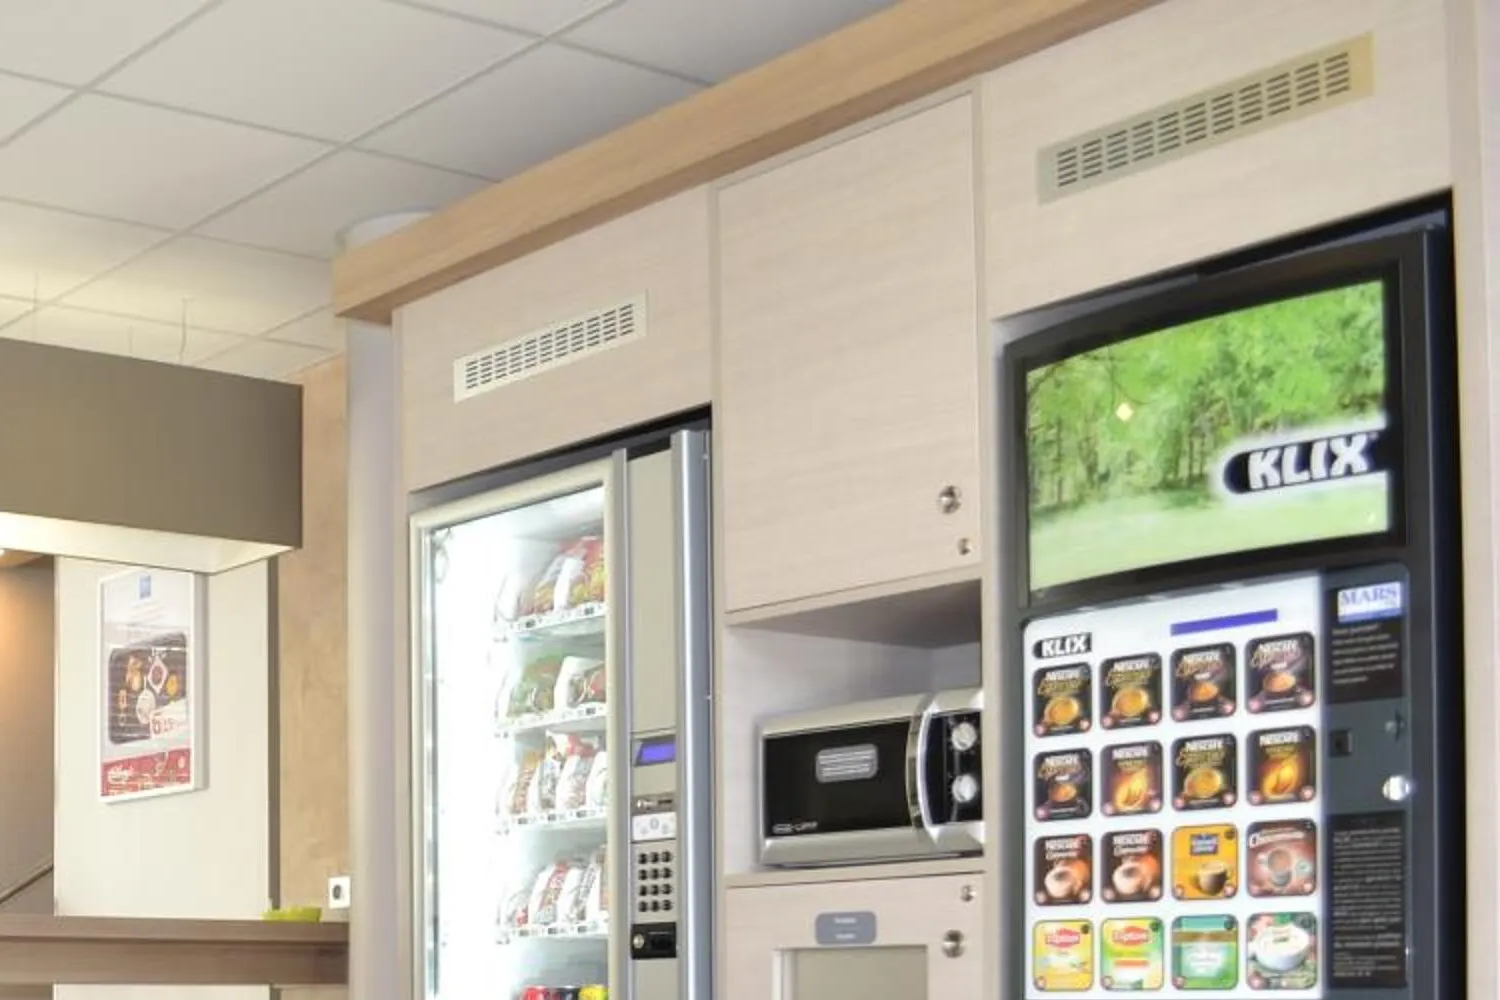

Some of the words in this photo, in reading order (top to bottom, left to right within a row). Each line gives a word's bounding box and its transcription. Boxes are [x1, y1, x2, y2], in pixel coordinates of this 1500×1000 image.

[1247, 433, 1369, 490] KLIX
[1341, 586, 1398, 605] MARS
[1041, 635, 1088, 657] KLIX
